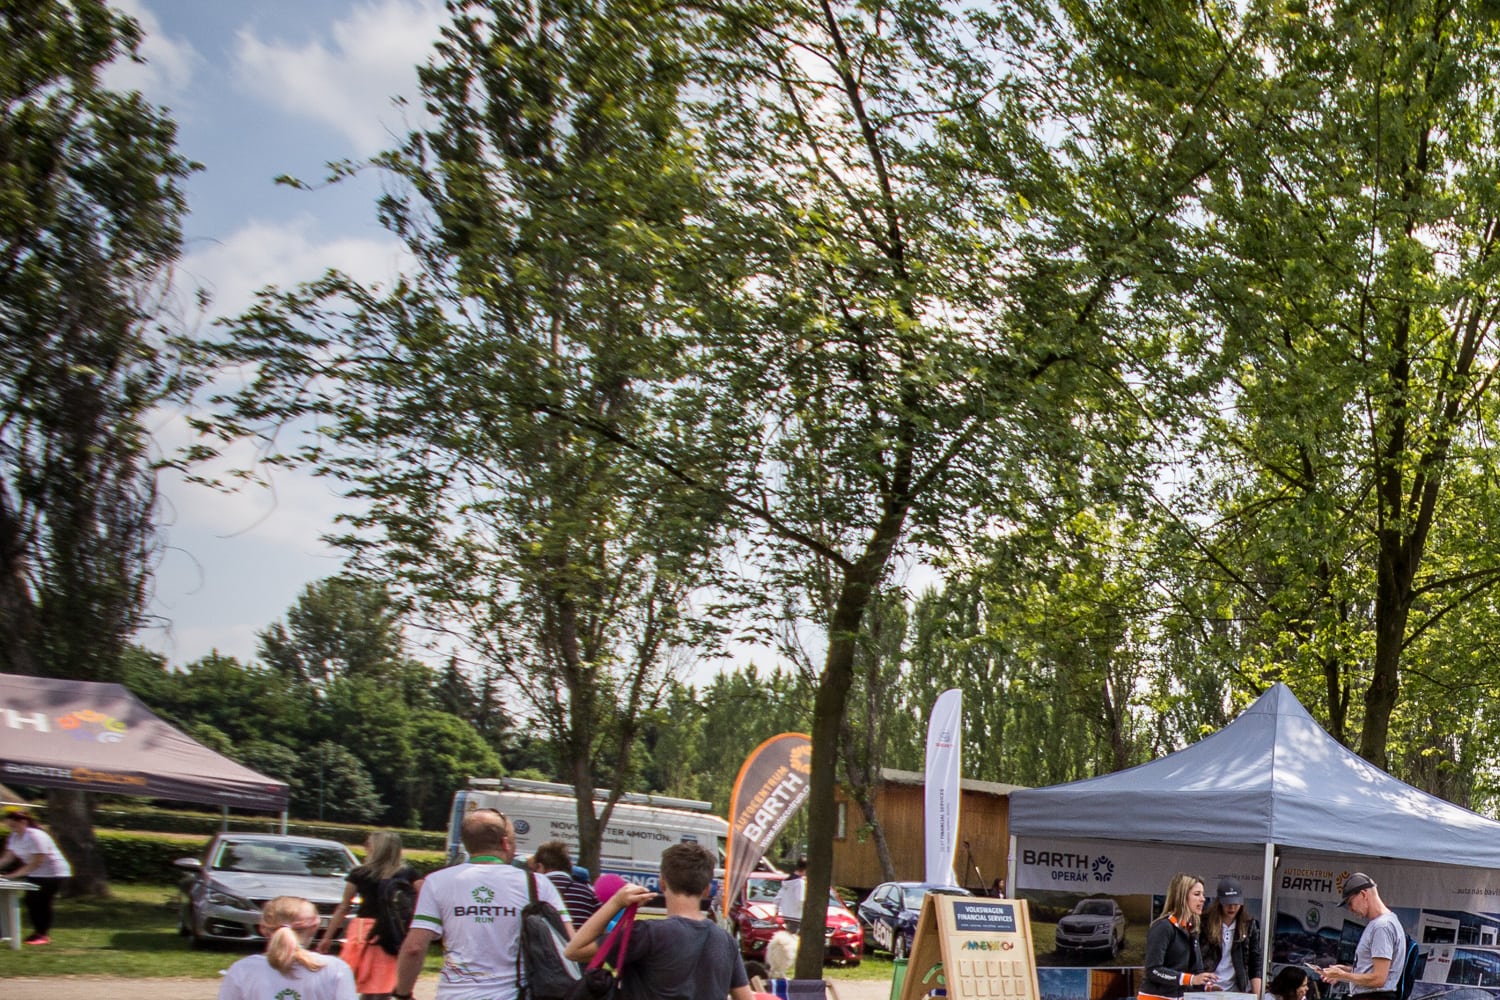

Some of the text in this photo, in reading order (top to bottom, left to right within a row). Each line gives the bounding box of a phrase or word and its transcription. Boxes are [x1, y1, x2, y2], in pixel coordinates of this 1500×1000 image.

[743, 772, 803, 842] BARTH
[1023, 849, 1089, 869] BARTH
[1051, 869, 1089, 882] OPERÁK
[1281, 876, 1333, 892] BARTH
[454, 905, 516, 917] BARTH
[965, 906, 1004, 914] VOLKSWAGEN
